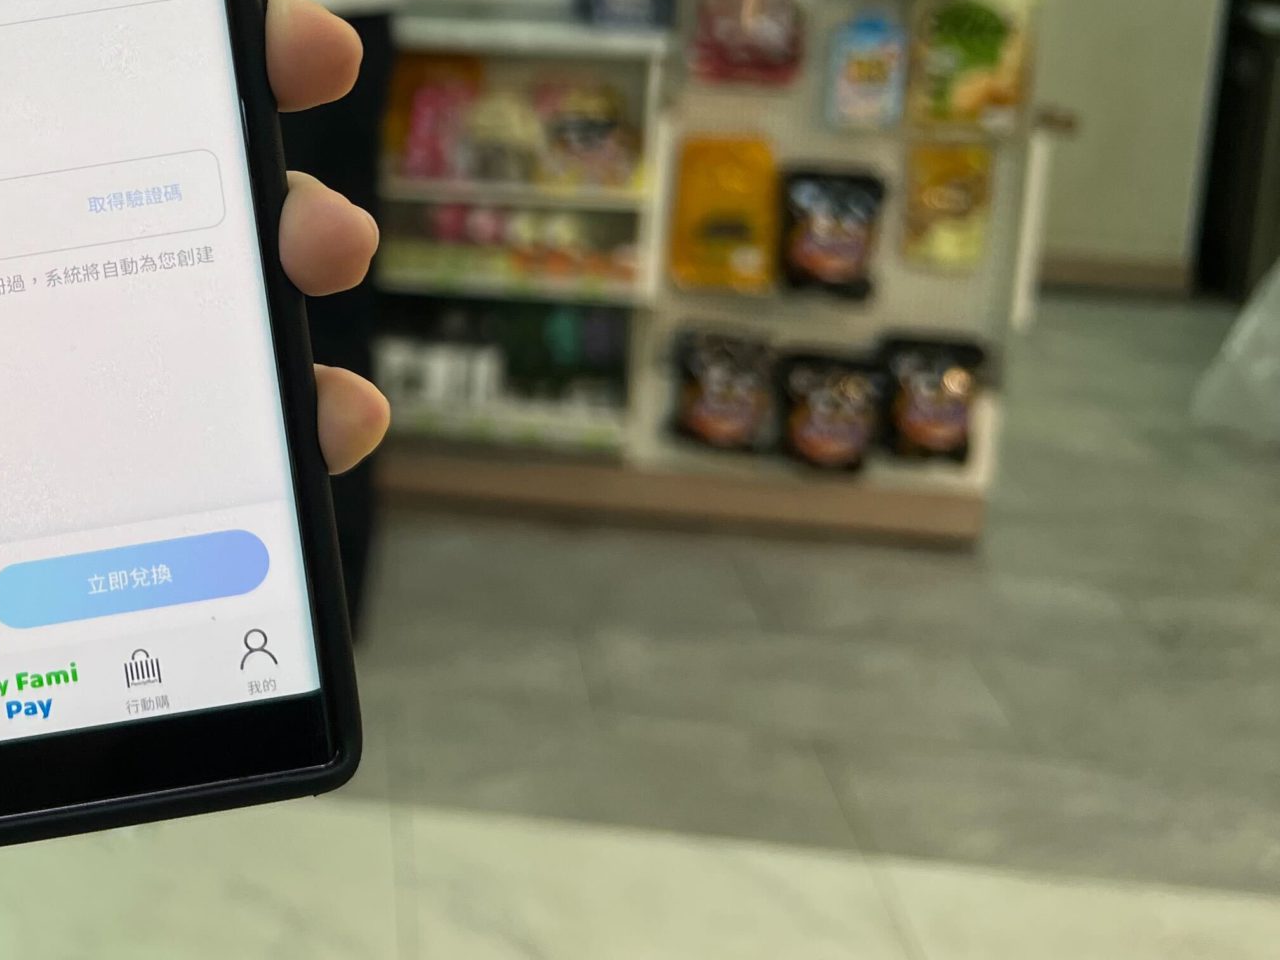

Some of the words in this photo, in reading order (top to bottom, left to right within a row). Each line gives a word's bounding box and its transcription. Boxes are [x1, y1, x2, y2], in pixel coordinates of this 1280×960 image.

[88, 183, 183, 214] 取得驗證碼
[87, 564, 173, 595] 立即兌換
[15, 661, 79, 691] Fami
[247, 678, 277, 696] 我的
[4, 693, 53, 722] Pay
[125, 694, 170, 716] 行動購
